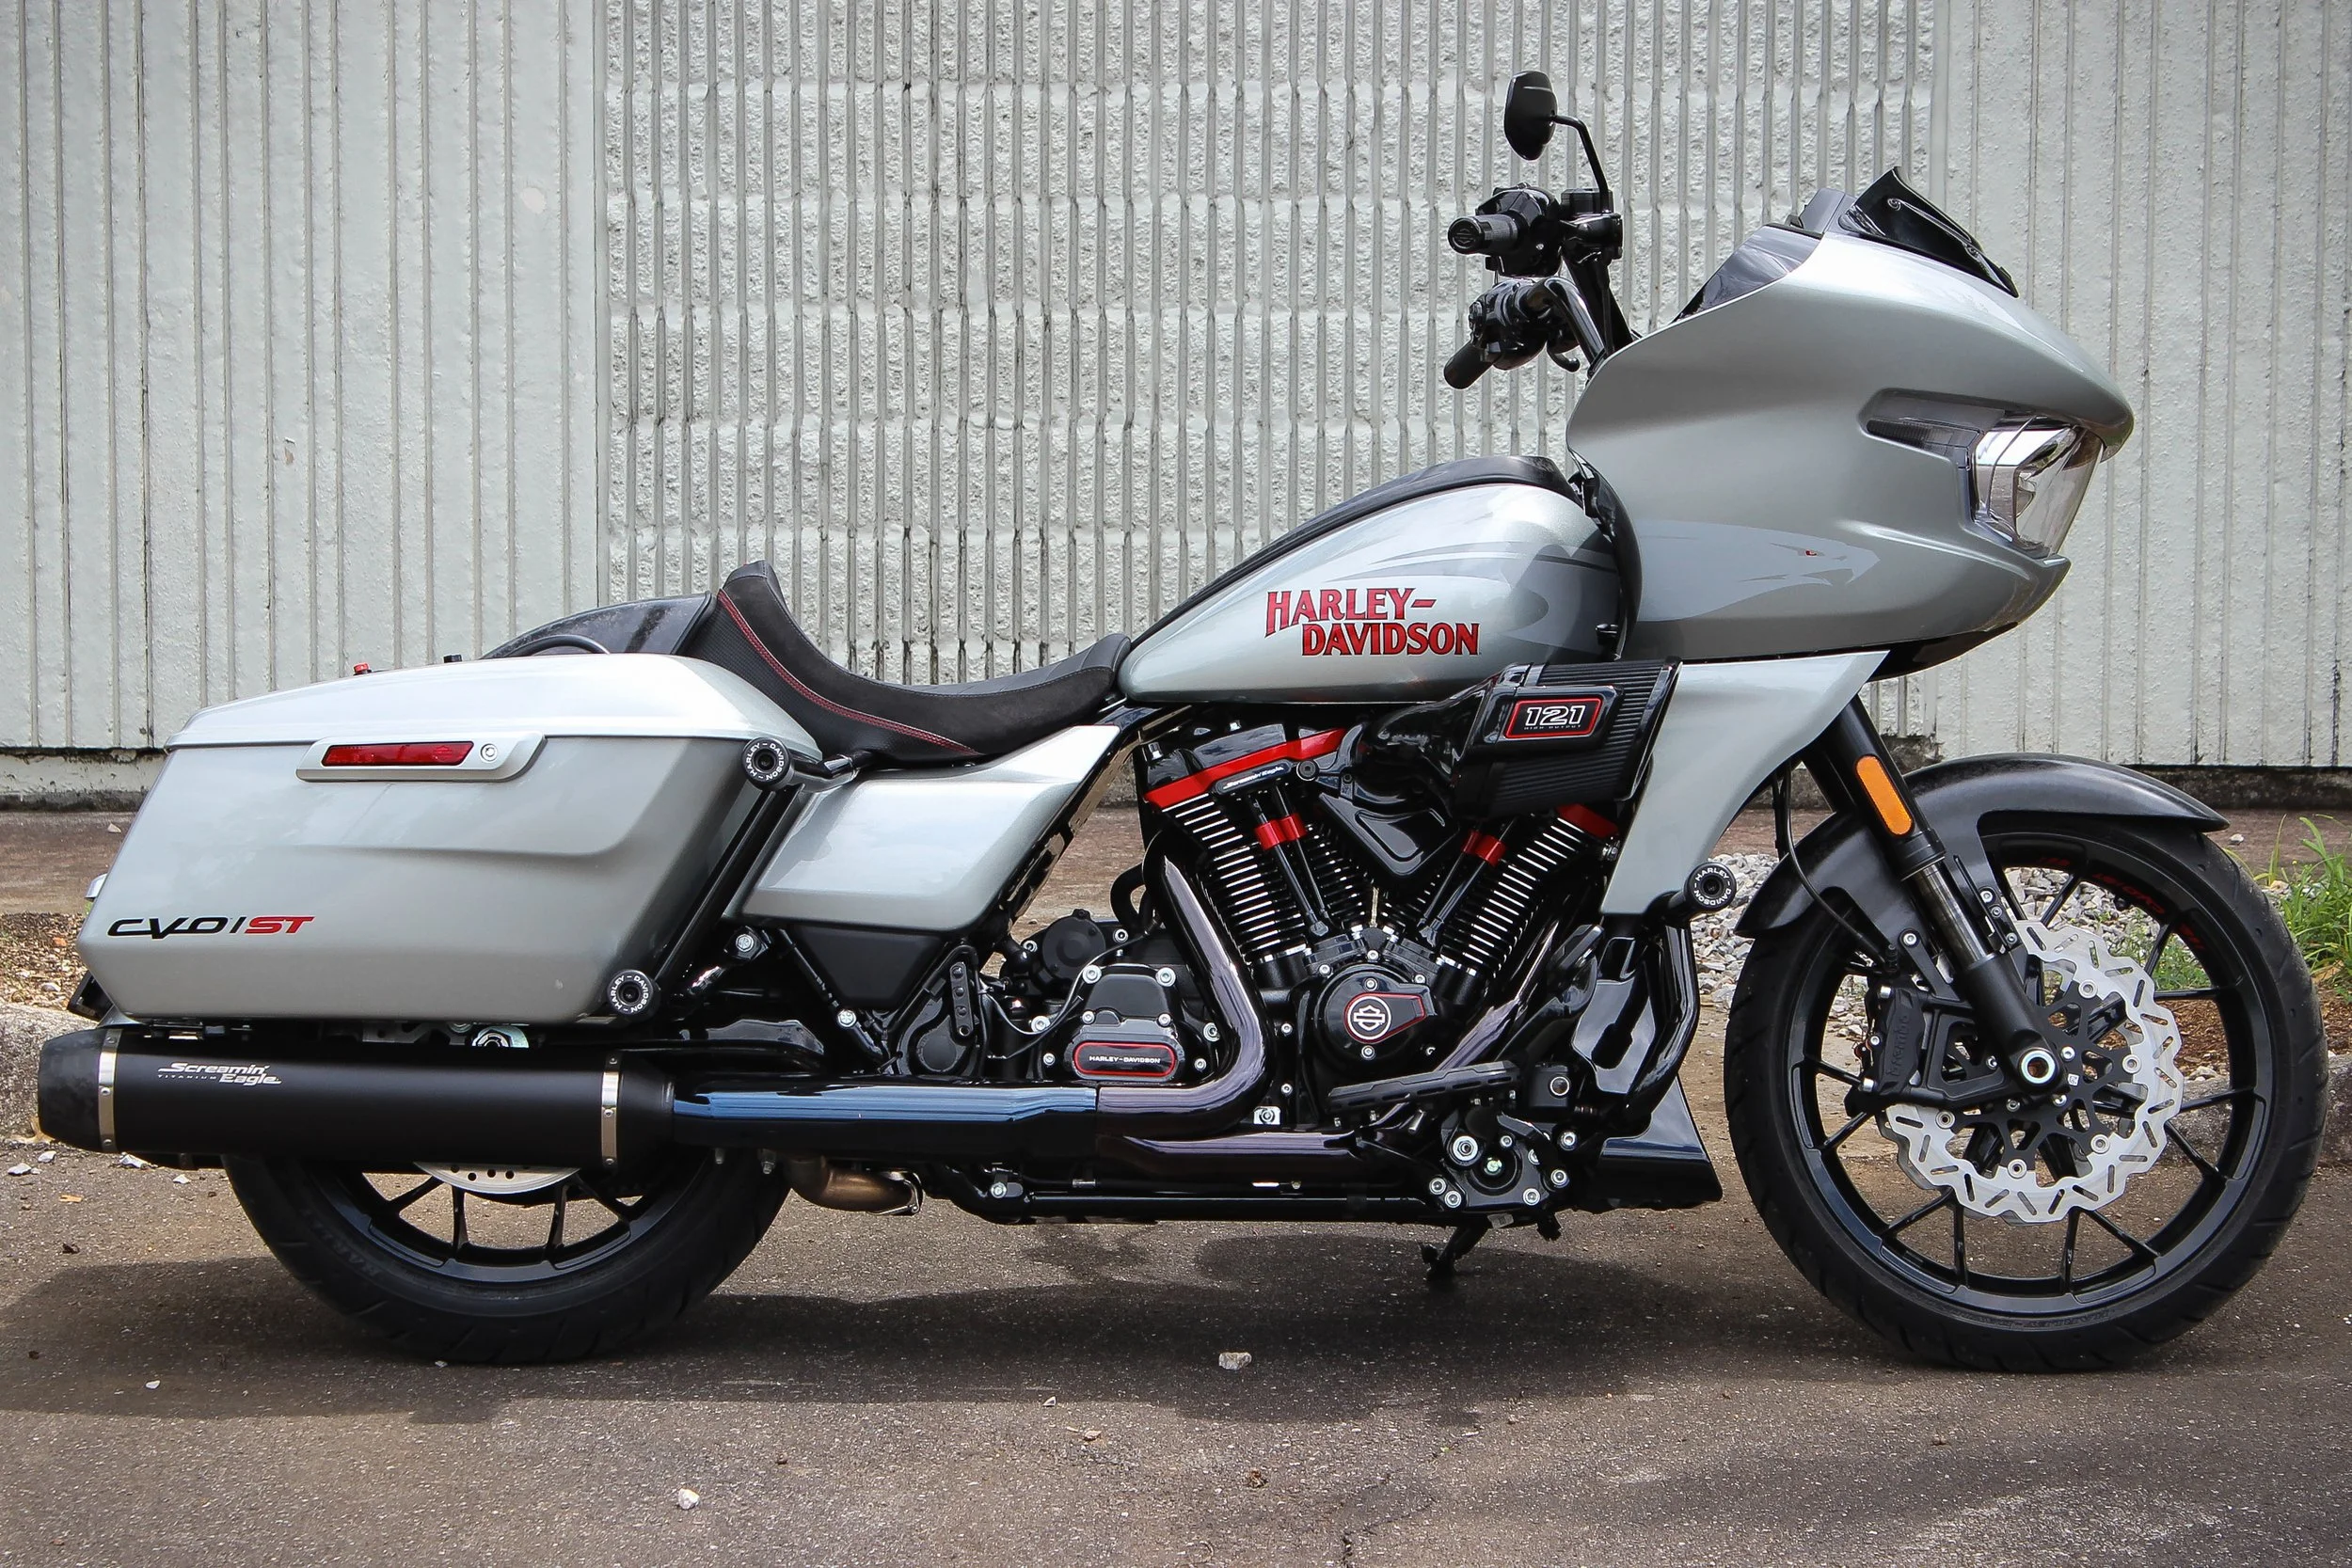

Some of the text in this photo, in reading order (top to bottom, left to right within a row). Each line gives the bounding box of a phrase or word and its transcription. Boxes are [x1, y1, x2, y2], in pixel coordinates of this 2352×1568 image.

[1264, 587, 1437, 639] HARLEY-
[1301, 622, 1480, 657] DAVIDSON
[1525, 705, 1586, 726] 121
[218, 1072, 282, 1086] Eagle
